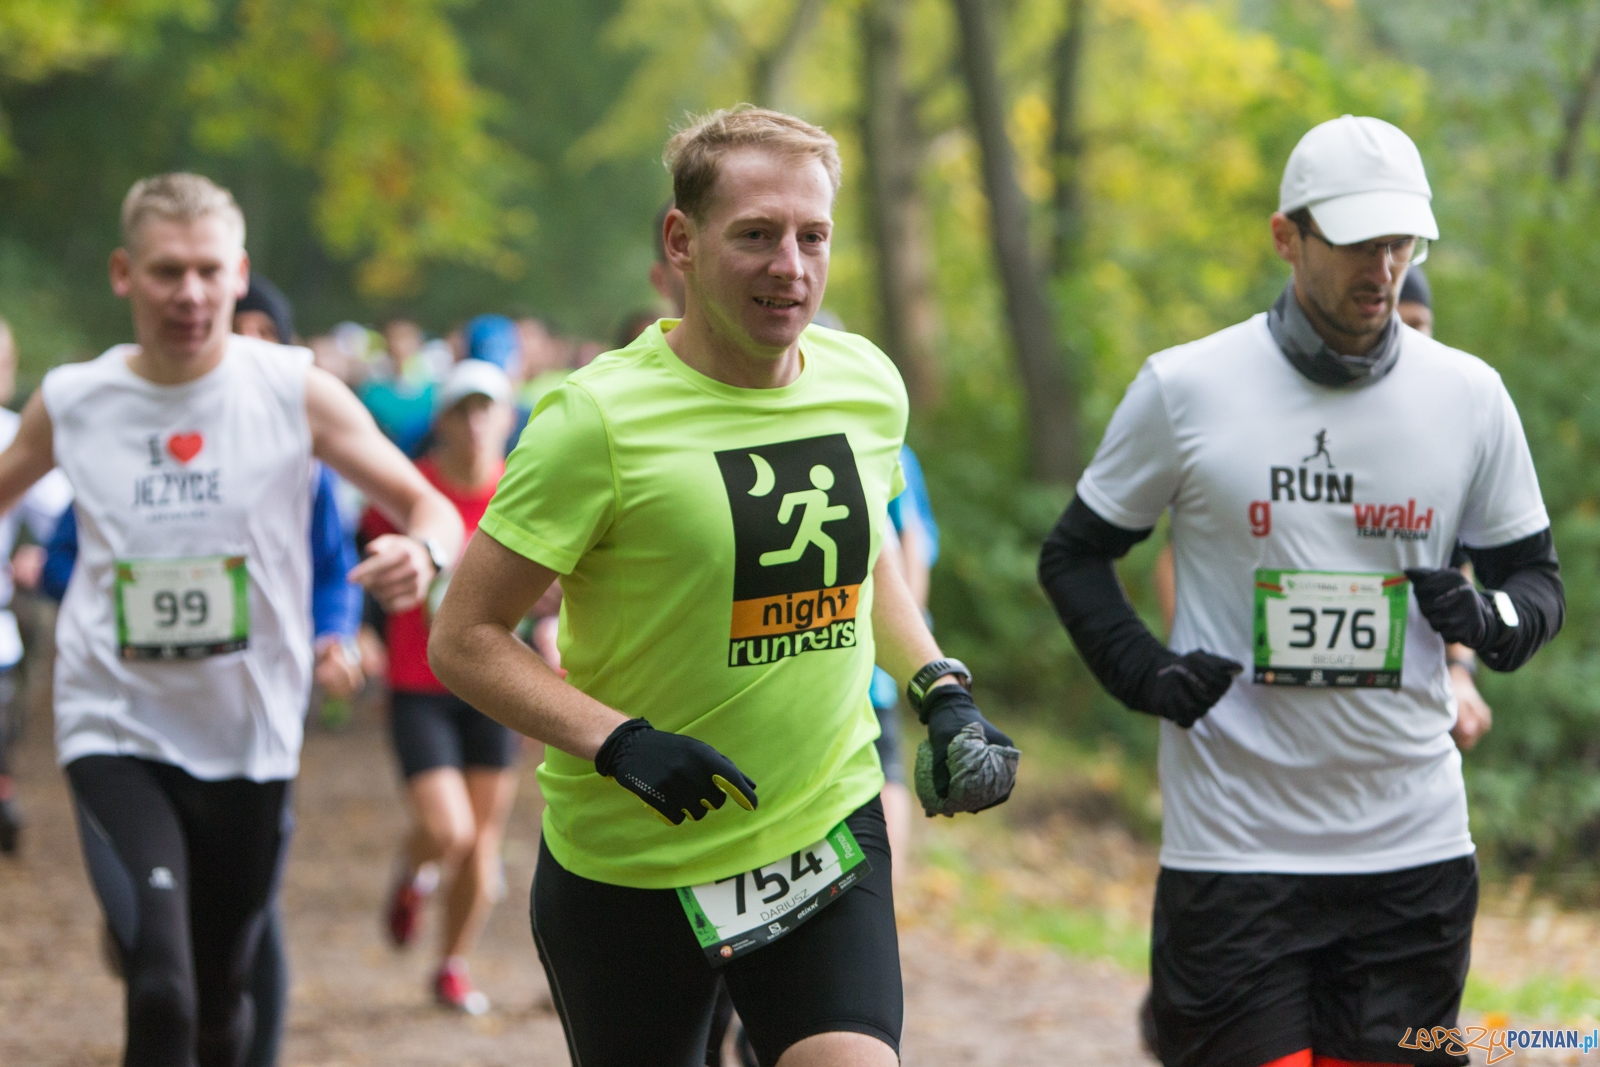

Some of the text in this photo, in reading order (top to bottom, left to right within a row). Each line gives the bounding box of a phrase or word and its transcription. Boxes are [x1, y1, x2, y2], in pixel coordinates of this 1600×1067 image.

[1270, 466, 1354, 503] RUN
[1248, 500, 1271, 538] g
[1357, 527, 1387, 538] TEAM
[154, 589, 208, 628] 99
[762, 588, 849, 630] night
[730, 620, 857, 666] runners
[1288, 607, 1377, 650] 376
[714, 850, 824, 916] 754
[760, 888, 812, 922] DARIUSZ
